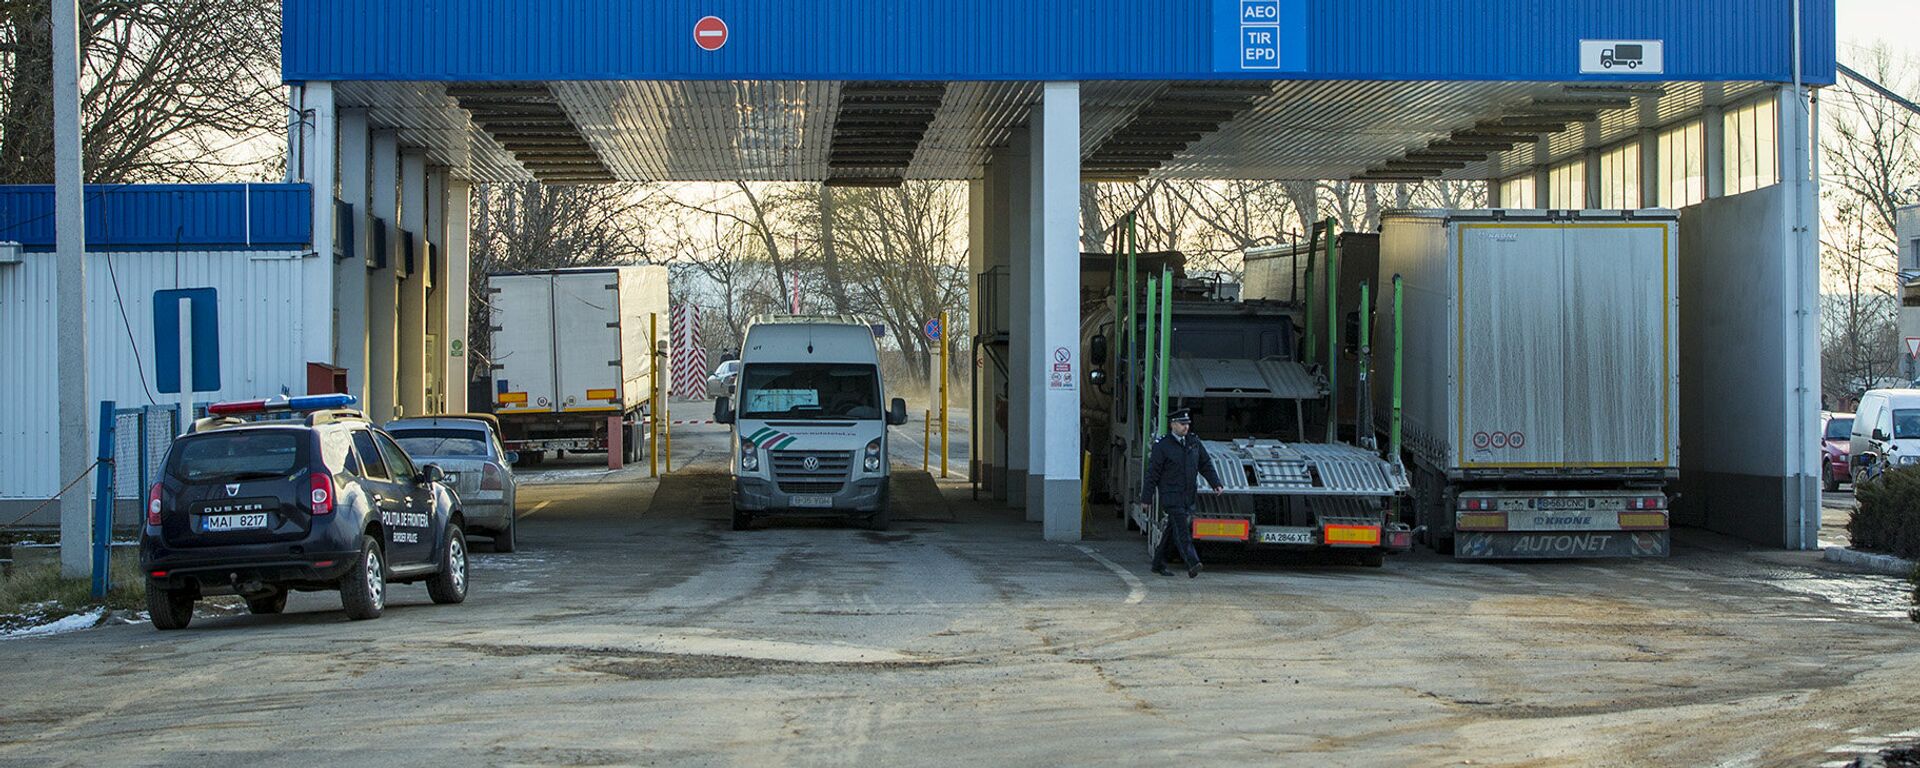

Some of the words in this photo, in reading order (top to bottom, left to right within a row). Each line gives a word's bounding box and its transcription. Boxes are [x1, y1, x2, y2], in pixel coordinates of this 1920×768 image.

[1244, 6, 1276, 18] AEO
[1247, 32, 1271, 44] TIR
[1246, 48, 1275, 60] EPD
[204, 503, 262, 513] DUSTER
[209, 516, 231, 528] MAI
[240, 515, 264, 527] 8217
[401, 512, 407, 526] DE
[1546, 516, 1592, 525] KRONE
[1513, 532, 1612, 554] AUTONET
